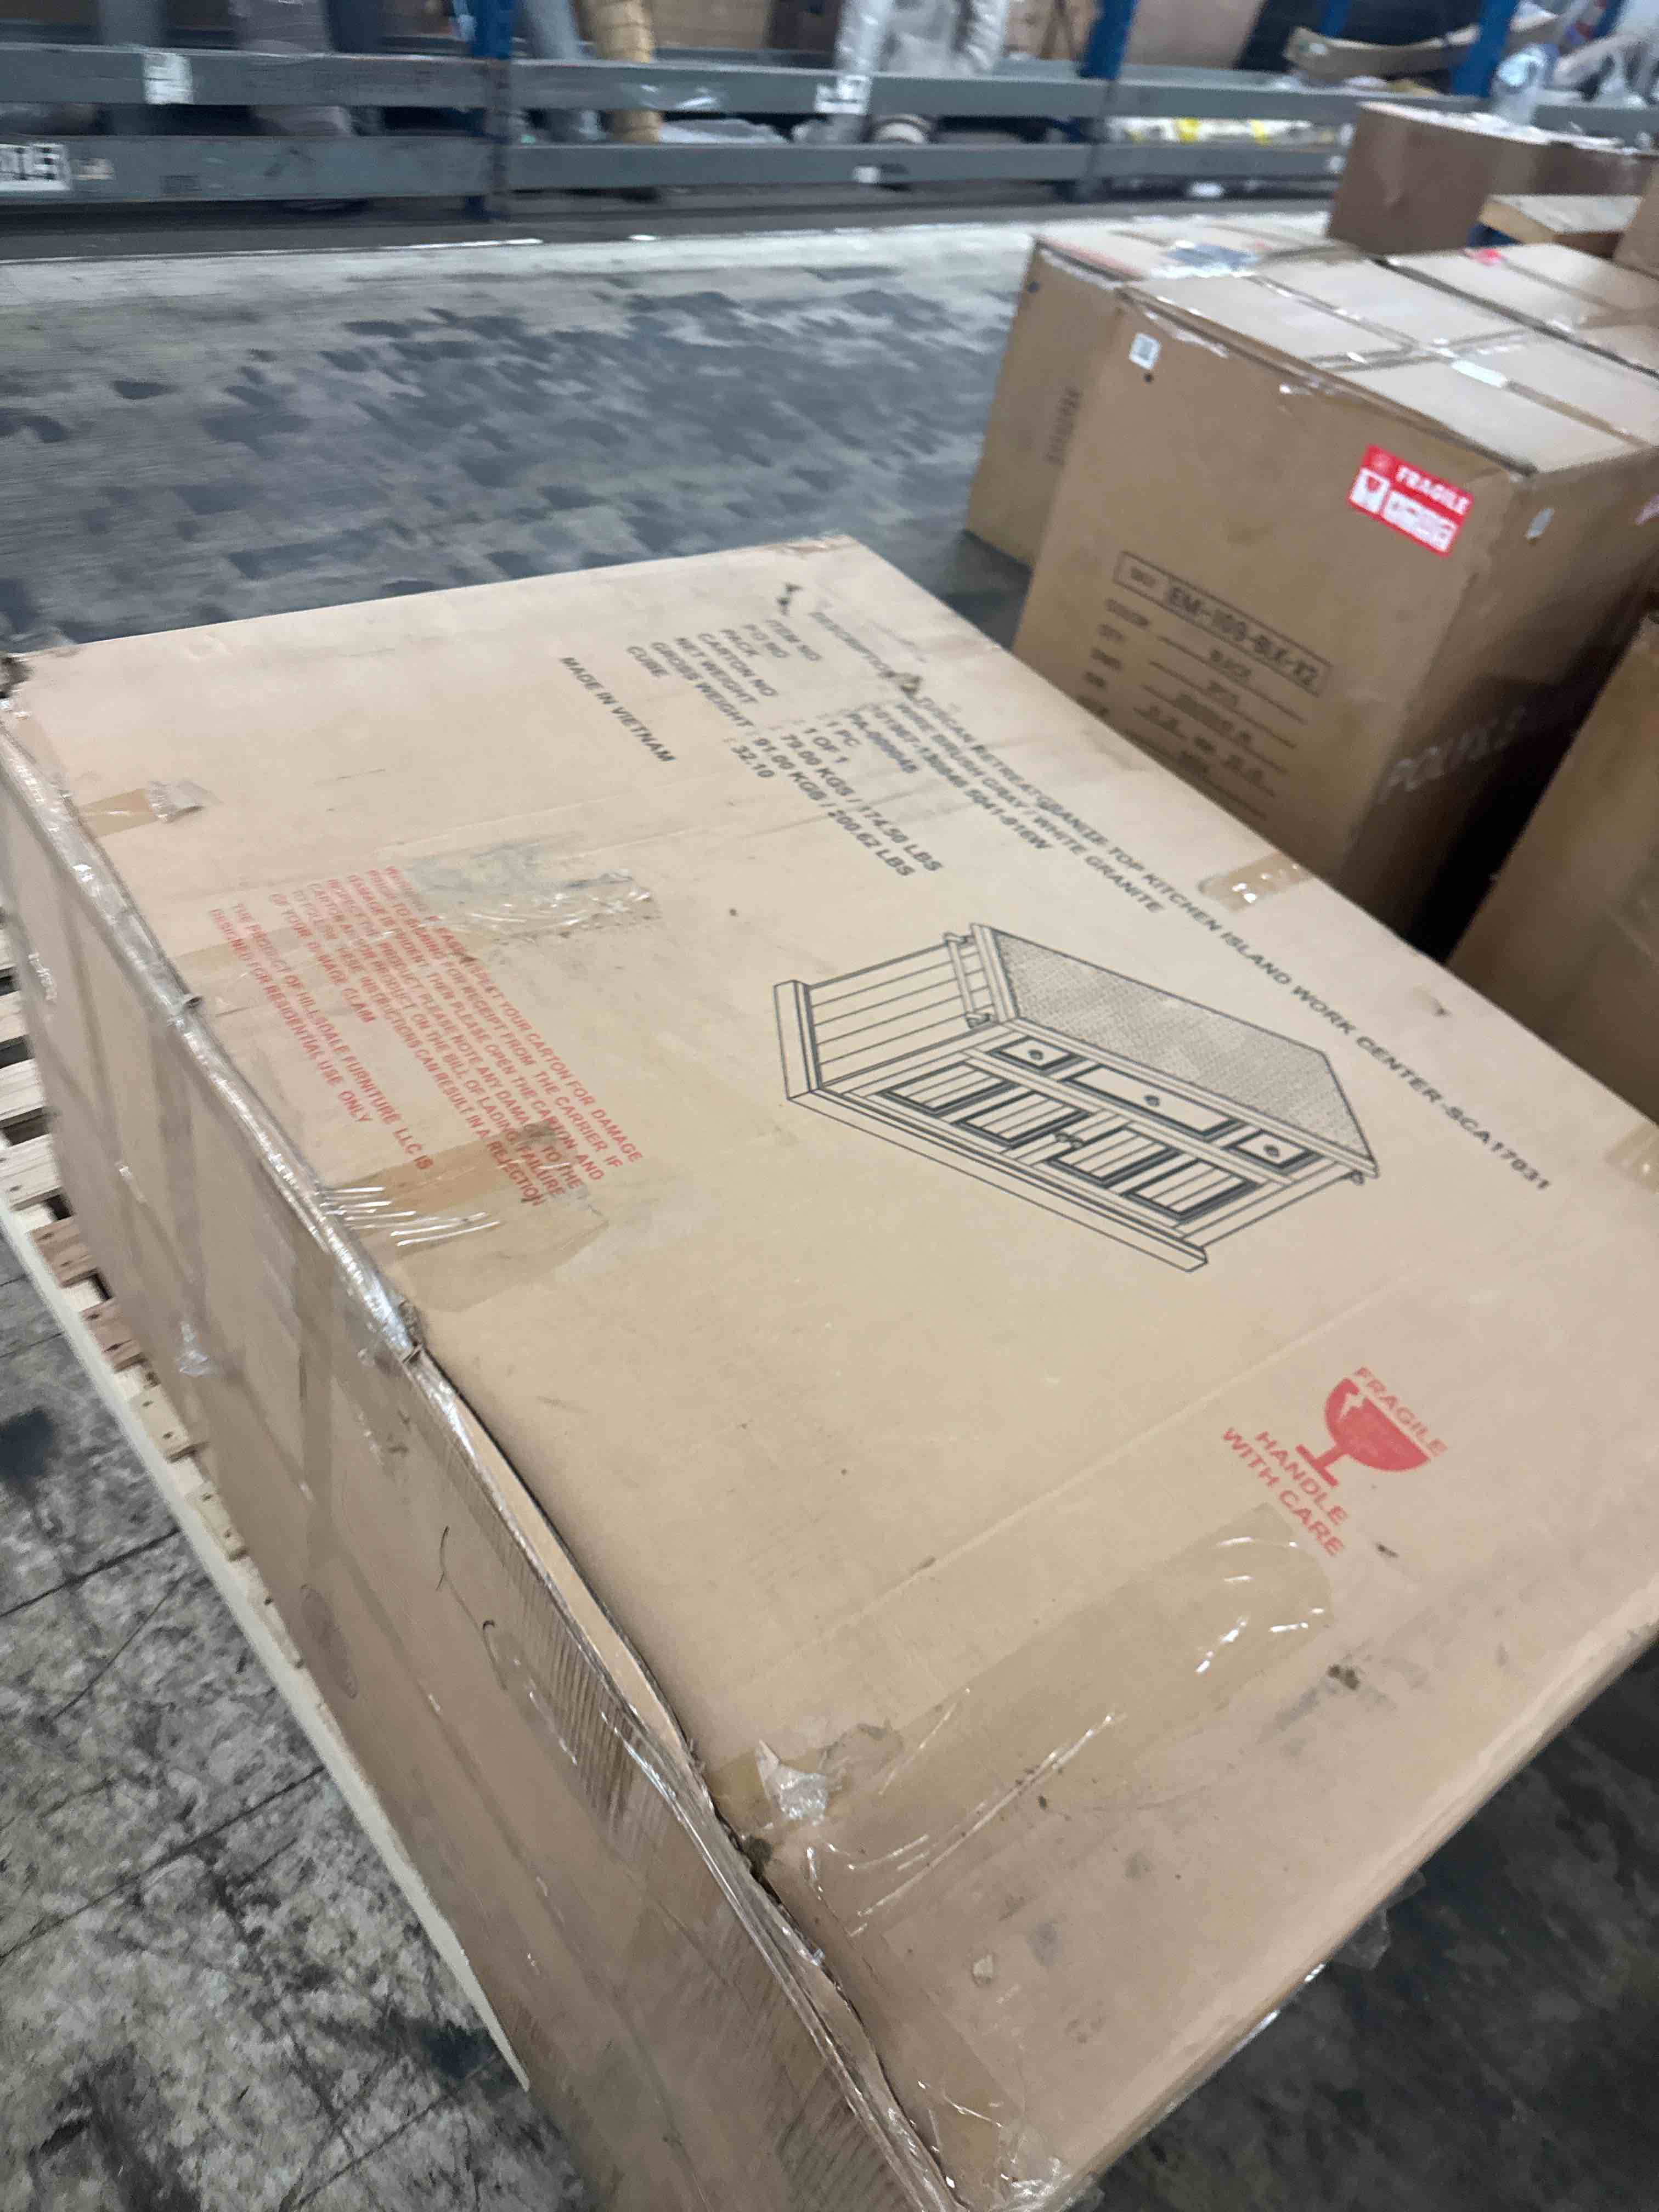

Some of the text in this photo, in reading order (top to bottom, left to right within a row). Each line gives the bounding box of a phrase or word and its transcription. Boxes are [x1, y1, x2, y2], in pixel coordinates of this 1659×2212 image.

[1395, 465, 1471, 516] FRAGILE
[694, 632, 757, 678] CARTON
[747, 678, 780, 698] NO
[810, 735, 841, 754] OF
[716, 628, 761, 657] PACK
[557, 656, 679, 765] MADE IN VIETNAM
[623, 645, 777, 780] CUBE 32.10
[648, 640, 704, 681] GROSS
[693, 682, 755, 729] WEIGHT
[786, 771, 830, 801] KGS
[873, 847, 916, 878] LBS
[672, 636, 707, 658] NET
[697, 659, 758, 704] WEIGHT
[812, 766, 857, 797] KGS
[901, 842, 945, 873] LBS
[806, 611, 901, 678] DESCRIPTIO
[1104, 846, 1145, 874] TOP
[1140, 872, 1222, 933] KITCHEN
[1217, 930, 1292, 987] ISLAND
[1289, 984, 1357, 1037] WORK
[979, 776, 1030, 811] GRAY
[1031, 815, 1088, 855] WHITE
[1082, 853, 1165, 915] GRANITE
[261, 985, 328, 1060] RESIDENTIAL
[314, 1060, 345, 1085] USE
[335, 1089, 373, 1124] ONLY
[281, 974, 306, 991] OF
[340, 1055, 403, 1124] FURNITURE
[391, 1126, 425, 1155] LLC
[339, 987, 379, 1023] CLAIM
[375, 942, 425, 990] PRODUCT
[416, 992, 460, 1034] PLEASE
[449, 1034, 484, 1064] NOTE
[474, 1065, 505, 1090] ANY
[493, 1089, 546, 1141] DAMAG
[538, 1144, 564, 1163] TO
[413, 1048, 442, 1072] CAN
[438, 960, 470, 984] FOR
[459, 985, 509, 1031] RECEIPT
[498, 1031, 539, 1066] FROM
[530, 1070, 562, 1094] THE
[551, 1096, 610, 1152] CARRIER
[600, 1155, 625, 1170] IF
[368, 960, 419, 1011] PRODUCT
[409, 1012, 433, 1029] ON
[424, 1031, 451, 1052] THE
[441, 1053, 472, 1079] BILL
[461, 1079, 486, 1096] OF
[475, 1097, 522, 1143] LADING
[513, 1145, 567, 1199] FAILURE
[424, 972, 458, 1000] THEN
[448, 1000, 494, 1043] PLEASE
[482, 1043, 520, 1075] OPEN
[510, 1076, 540, 1100] THE
[529, 1099, 581, 1150] CARTON
[572, 1153, 607, 1181] AND
[431, 1072, 475, 1114] RESULT
[464, 1114, 486, 1127] IN
[474, 1127, 494, 1138] A
[496, 1000, 534, 1031] YOUR
[523, 1032, 575, 1080] CARTON
[564, 1080, 597, 1106] FOR
[588, 1108, 646, 1163] DAMAGE
[484, 1141, 547, 1207] REJECTION
[1355, 1366, 1448, 1458] FRAGILE
[1221, 1426, 1344, 1557] WITH CARE
[1254, 1431, 1348, 1526] HANDLE
